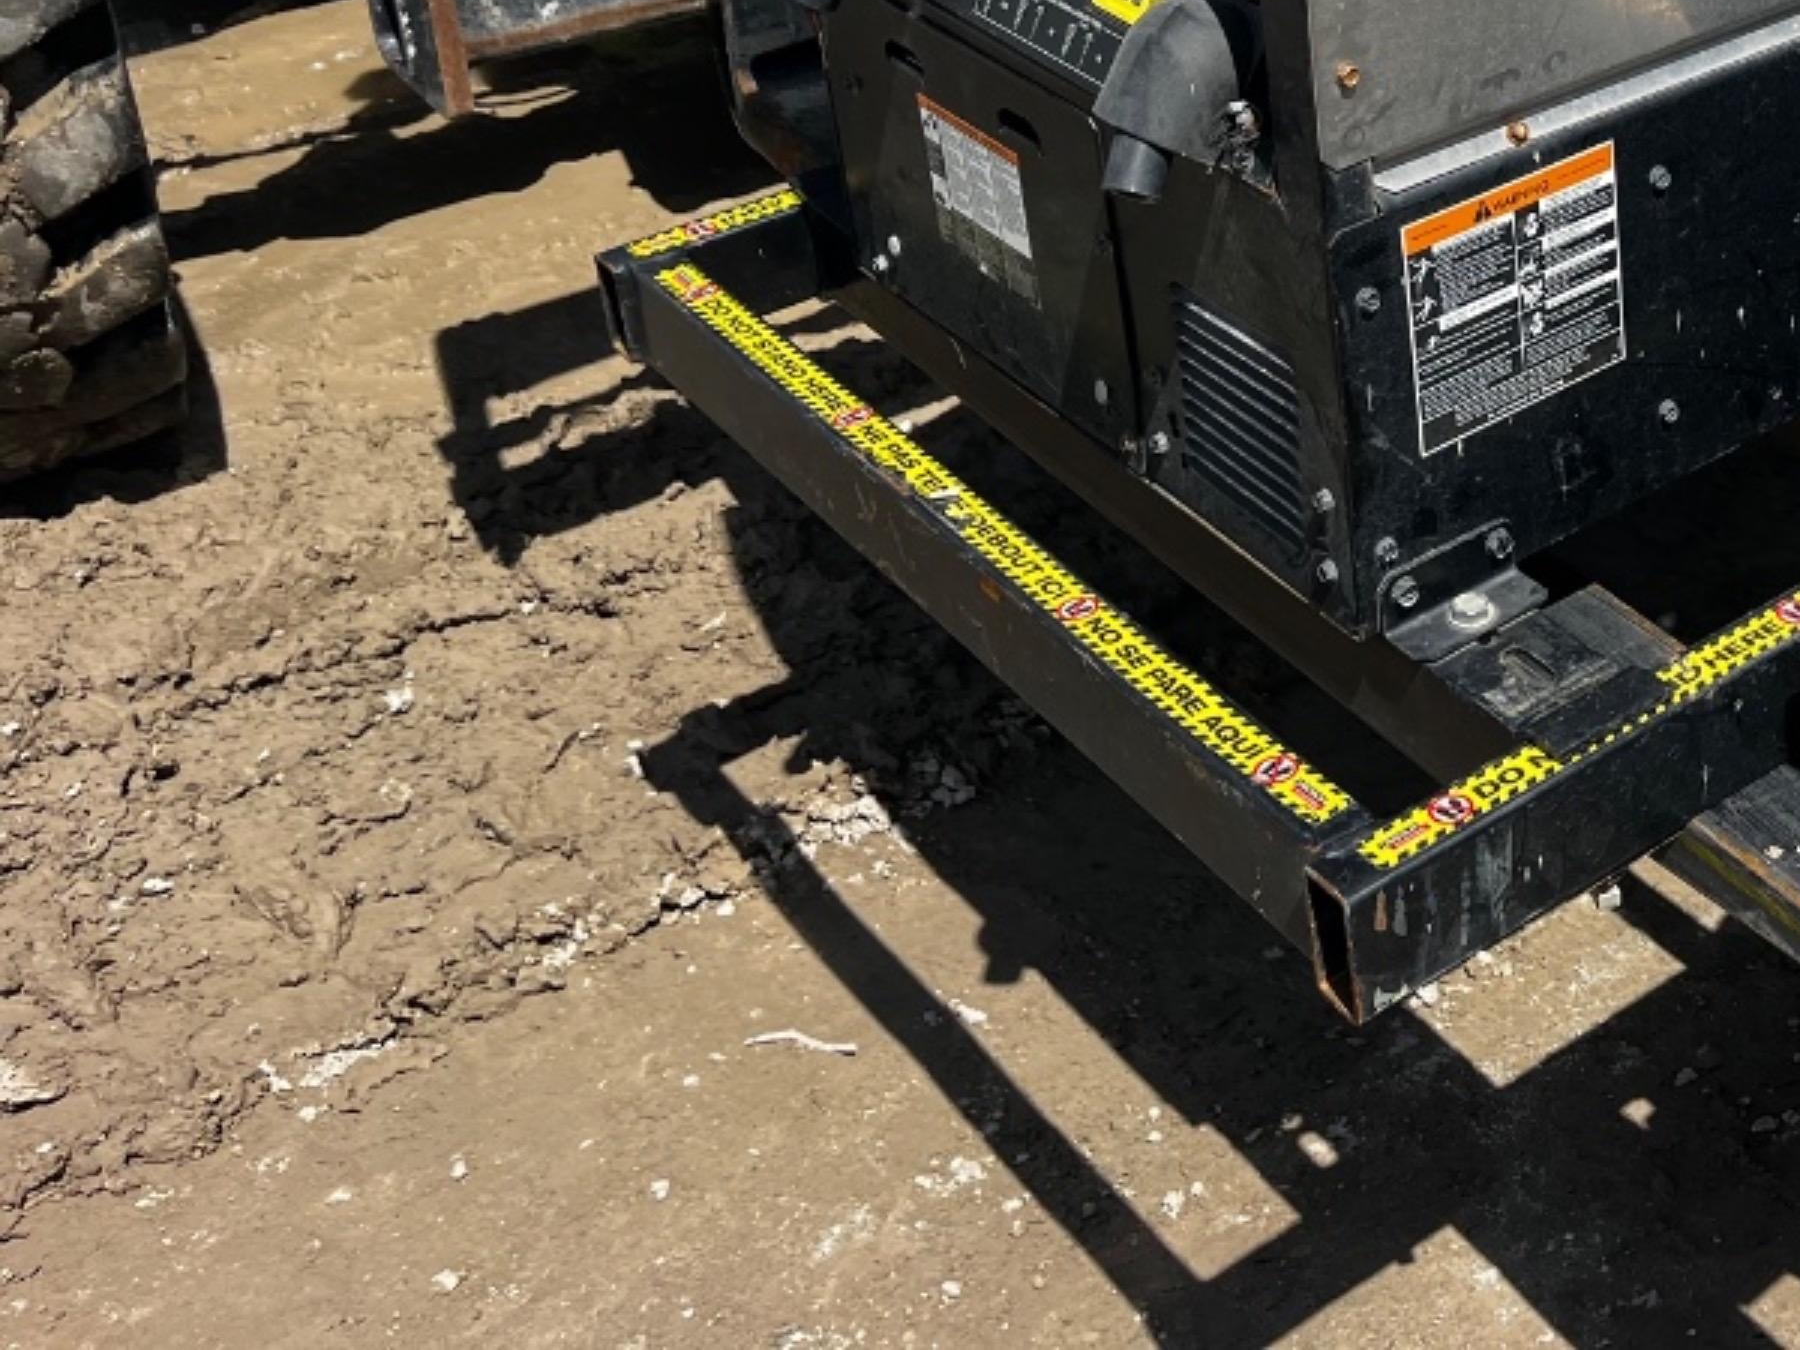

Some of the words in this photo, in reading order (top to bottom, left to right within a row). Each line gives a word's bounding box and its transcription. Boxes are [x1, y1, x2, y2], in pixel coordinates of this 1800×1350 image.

[883, 442, 923, 469] PAS
[1702, 619, 1784, 669] HERE
[1086, 616, 1123, 645] NO
[1115, 643, 1153, 670] SE
[1146, 668, 1210, 717] PARE
[1471, 766, 1527, 800] DO
